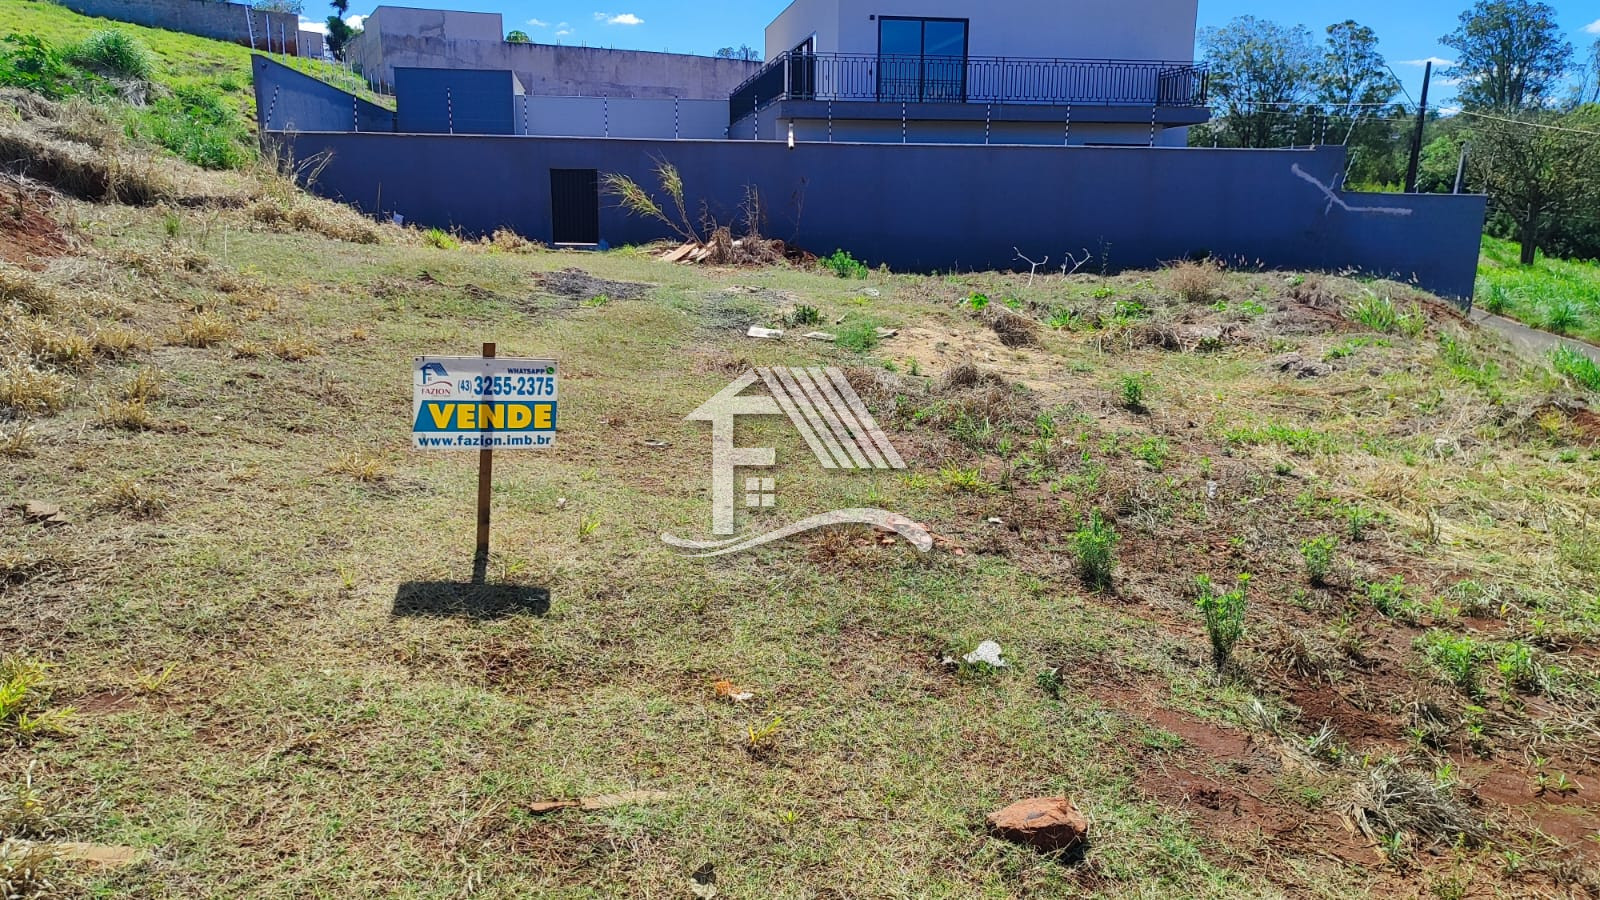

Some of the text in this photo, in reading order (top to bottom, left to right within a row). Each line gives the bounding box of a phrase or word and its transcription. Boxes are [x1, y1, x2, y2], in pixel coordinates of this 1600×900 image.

[458, 376, 554, 396] (43) 3255-2375
[428, 404, 552, 429] VENDE
[418, 435, 551, 446] www.fazion.imb.br
